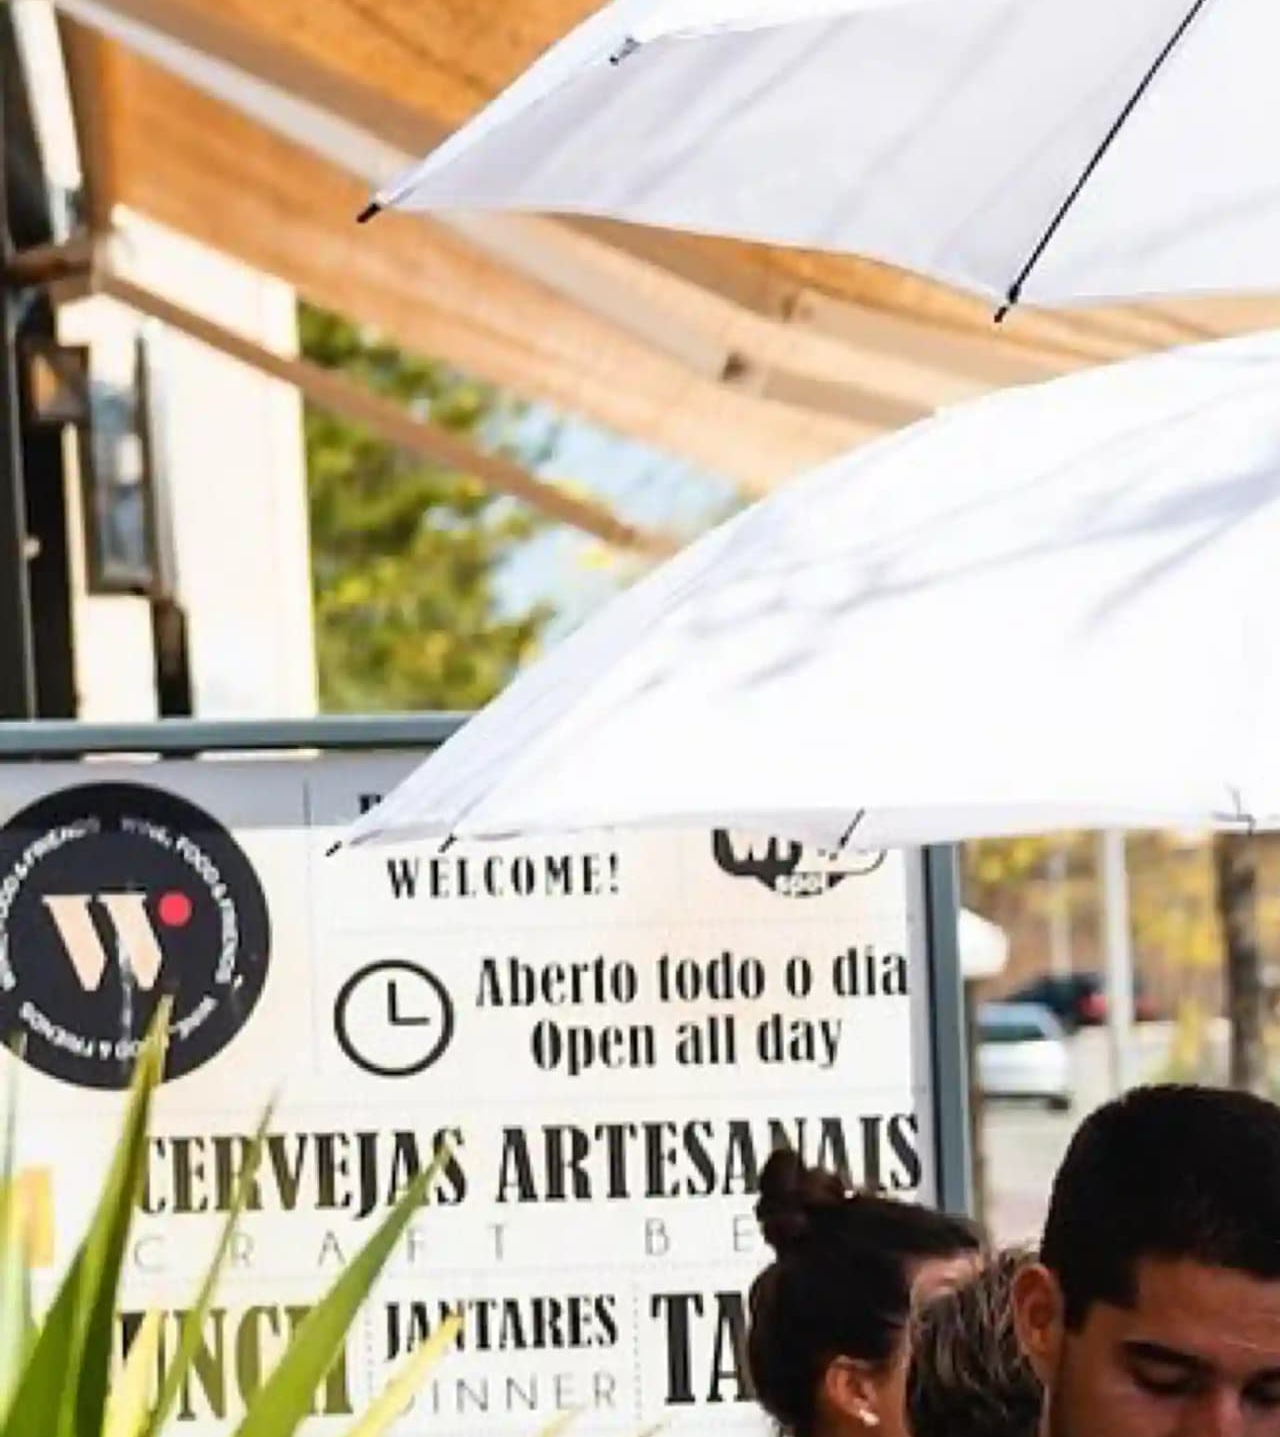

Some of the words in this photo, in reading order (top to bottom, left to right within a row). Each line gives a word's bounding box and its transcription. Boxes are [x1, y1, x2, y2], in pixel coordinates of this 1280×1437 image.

[386, 852, 620, 901] WELCOME!
[475, 955, 638, 1008] Aberto
[657, 951, 766, 1004] todo
[785, 955, 813, 999] o
[831, 945, 910, 997] dia
[530, 1018, 657, 1076] Open
[675, 1014, 738, 1065] all
[756, 1013, 843, 1070] day
[141, 1125, 468, 1222] CERVEJAS
[386, 1293, 619, 1361] JANTARES
[402, 1371, 617, 1415] INNER
